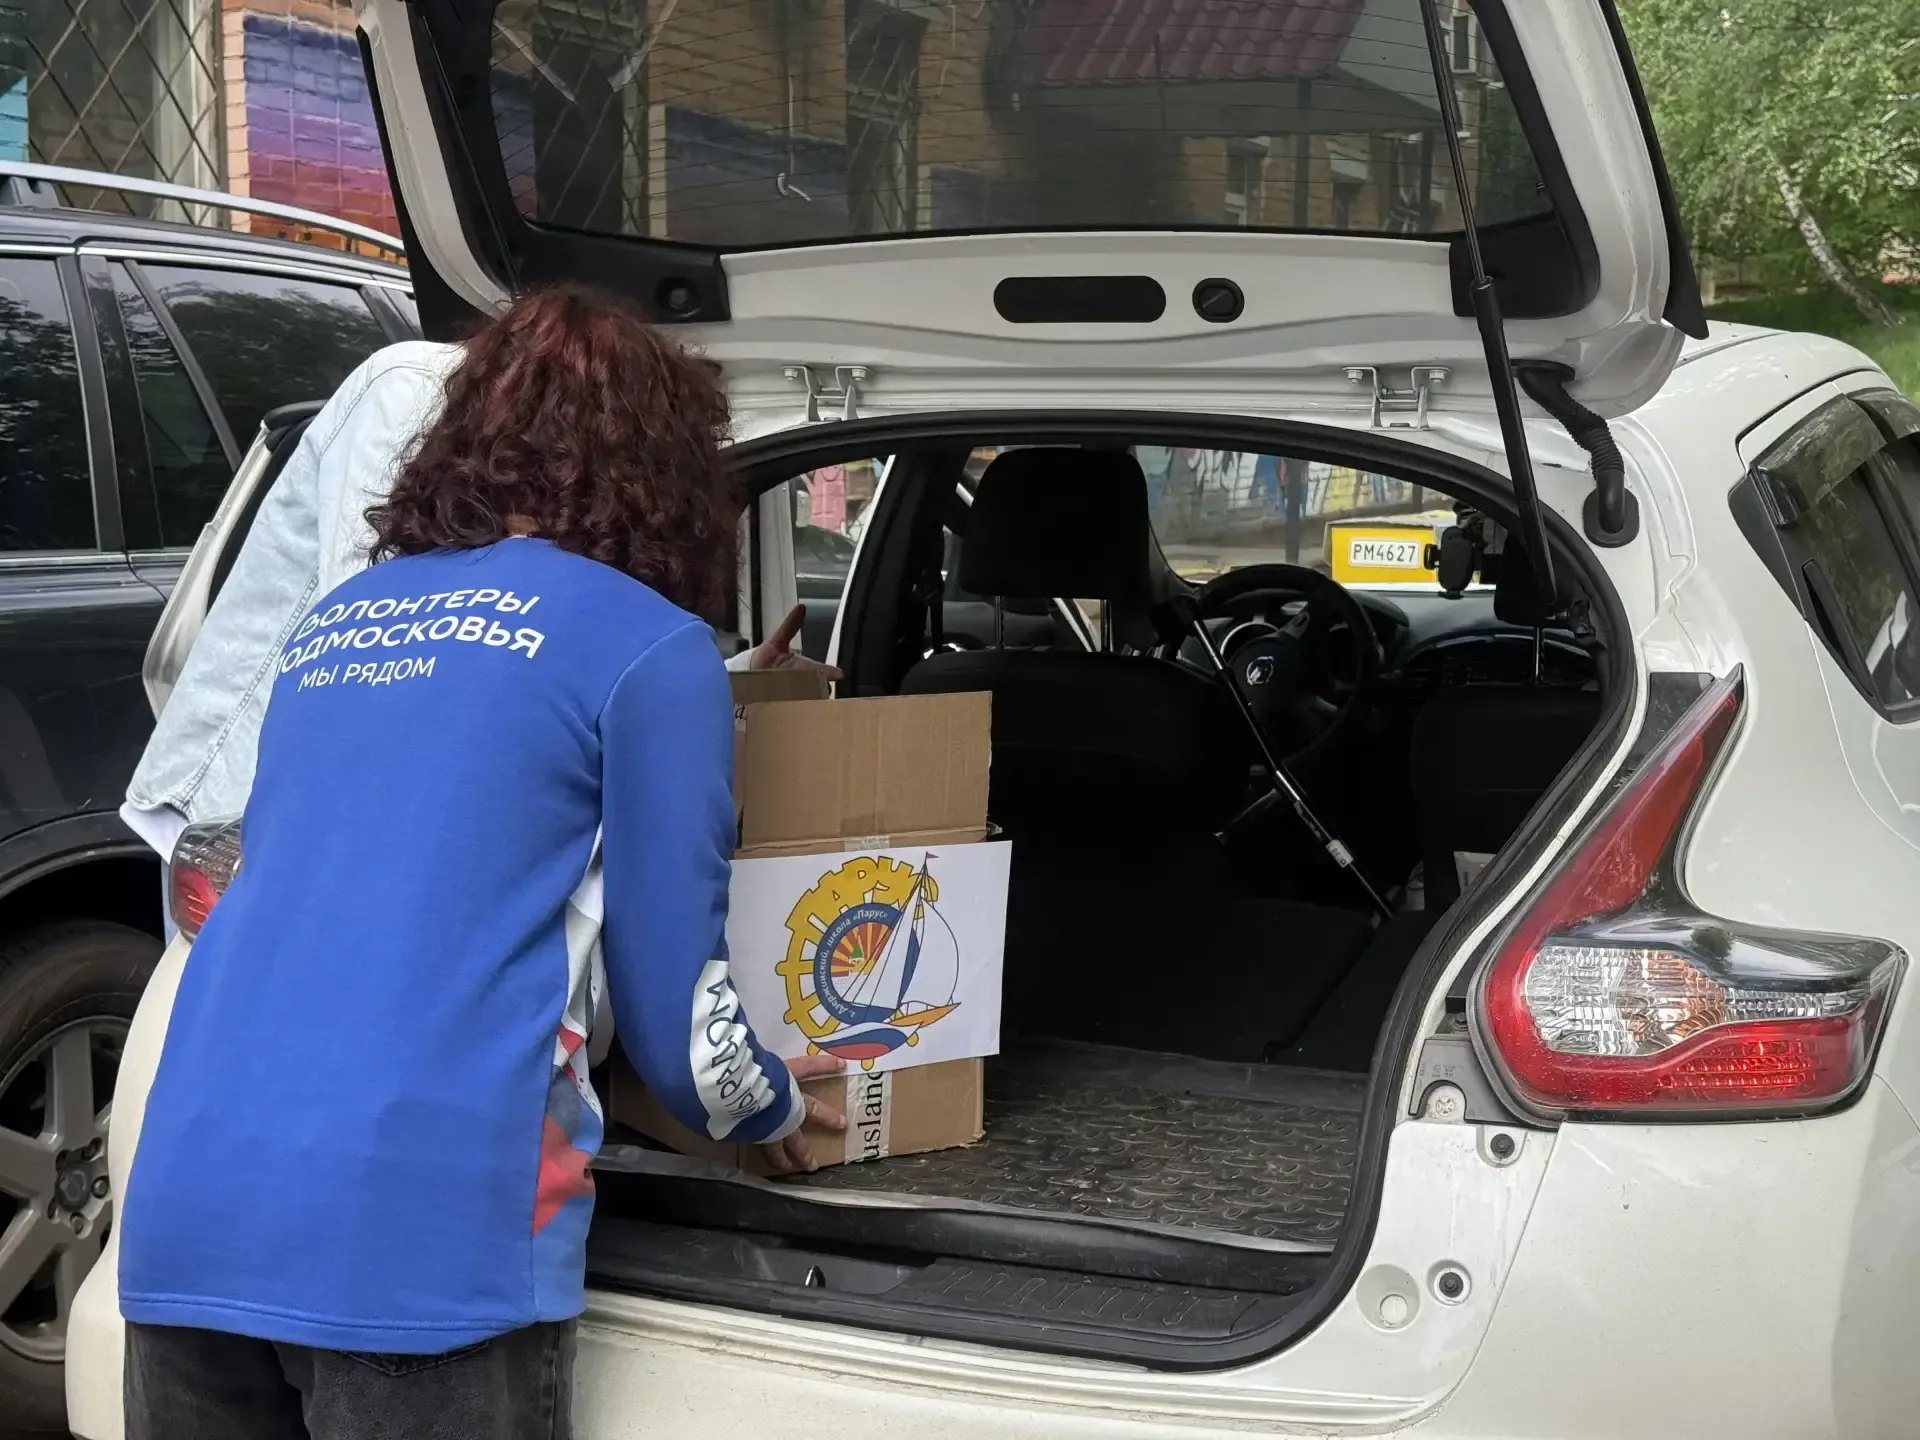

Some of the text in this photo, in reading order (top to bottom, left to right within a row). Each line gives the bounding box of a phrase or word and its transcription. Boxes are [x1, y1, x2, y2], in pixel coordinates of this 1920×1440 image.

[293, 588, 541, 643] ВОЛОНТЕРЫ
[296, 656, 436, 692] МЫ РЯДОМ
[857, 1071, 884, 1160] uslan
